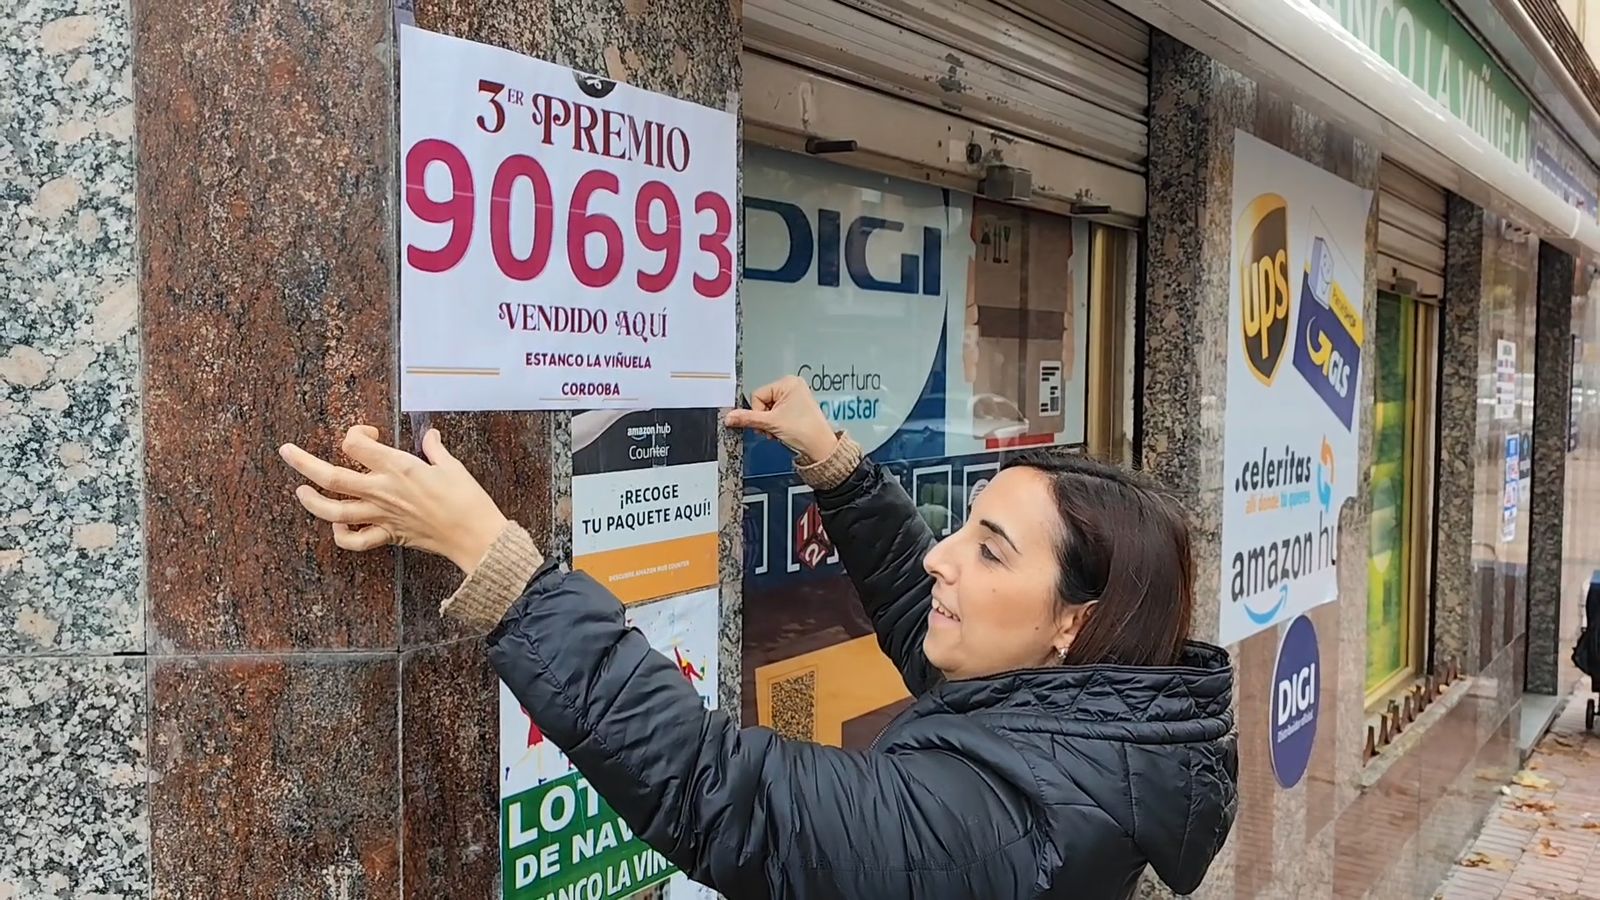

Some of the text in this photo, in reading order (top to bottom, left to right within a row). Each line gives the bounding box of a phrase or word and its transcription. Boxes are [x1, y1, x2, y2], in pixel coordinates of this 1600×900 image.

[531, 93, 690, 172] PREMIO
[405, 138, 732, 298] 90693
[743, 196, 942, 296] DIGI
[498, 302, 668, 342] VENDIDO AQUÍ
[1243, 248, 1289, 360] ups
[525, 352, 652, 369] ESTANCO LA VIÑUELA
[797, 364, 881, 391] Cobertura
[1328, 350, 1351, 398] GLS
[561, 382, 620, 396] CORDOBA
[819, 395, 879, 420] ovistar
[627, 422, 672, 437] amazon hub
[628, 444, 670, 460] Counter
[620, 484, 679, 510] ¡RECOGE
[582, 498, 711, 535] TU PAQUETE AQUÍ!
[1231, 531, 1313, 602] amazon
[1277, 662, 1316, 726] DIGI
[515, 842, 561, 889] DE
[606, 860, 631, 896] LA
